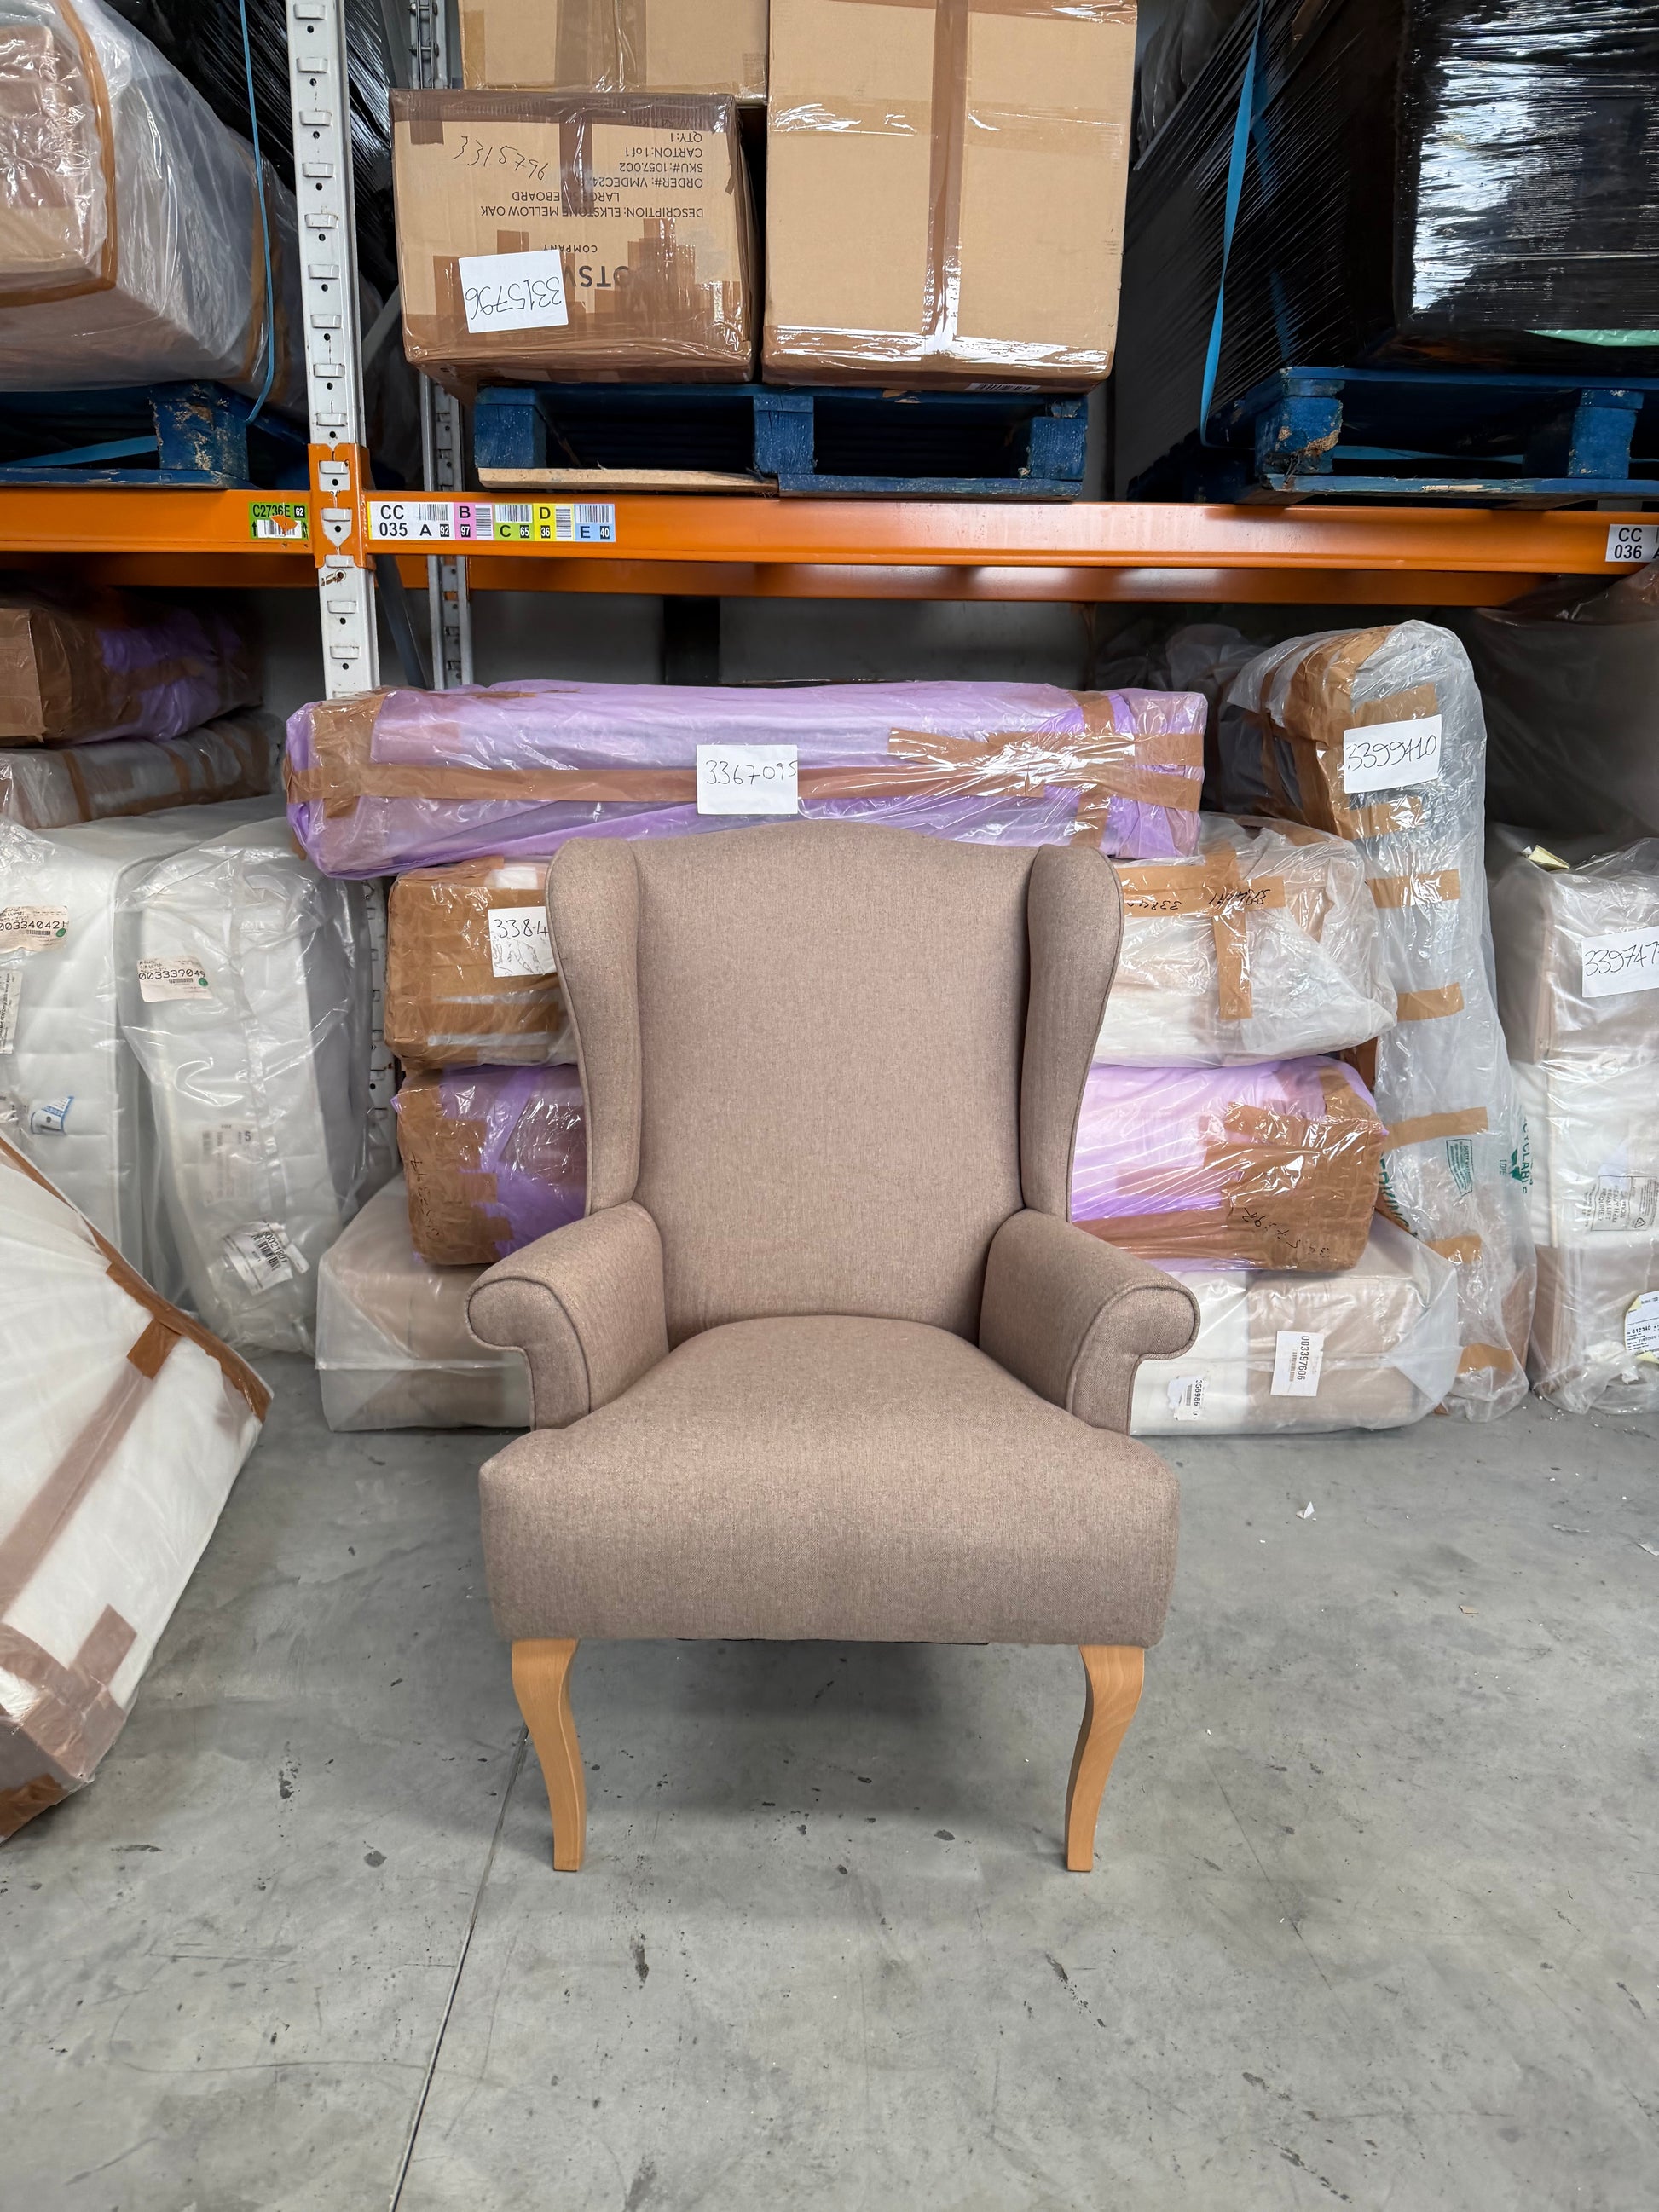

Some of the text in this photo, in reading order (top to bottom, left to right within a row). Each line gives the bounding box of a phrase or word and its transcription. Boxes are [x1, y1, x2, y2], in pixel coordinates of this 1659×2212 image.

[677, 130, 702, 143] QTY:
[452, 135, 549, 181] 3315796
[632, 147, 643, 158] of
[651, 147, 703, 159] CARTON:
[619, 162, 704, 173] SKU#: 1057.002
[651, 177, 703, 188] ORDER#:
[512, 191, 580, 203] SIEBOARD
[480, 205, 704, 218] DESCRIPTION: ELKSTONE MELLOW OAK
[543, 245, 598, 253] COMPANY
[465, 276, 563, 321] 3315796
[252, 504, 304, 518] C2736E 62
[380, 505, 405, 520] CC
[459, 505, 471, 519] B
[539, 506, 552, 520] D
[379, 522, 450, 537] 035 A 92
[460, 524, 471, 537] 97
[500, 524, 529, 538] C 65
[540, 527, 551, 537] 36
[580, 525, 610, 539] E 40
[1618, 527, 1643, 543] CC
[1614, 544, 1643, 559] 036
[1346, 734, 1437, 771] 3399410
[1584, 940, 1659, 977] 339747
[1297, 1335, 1310, 1381] 003397606
